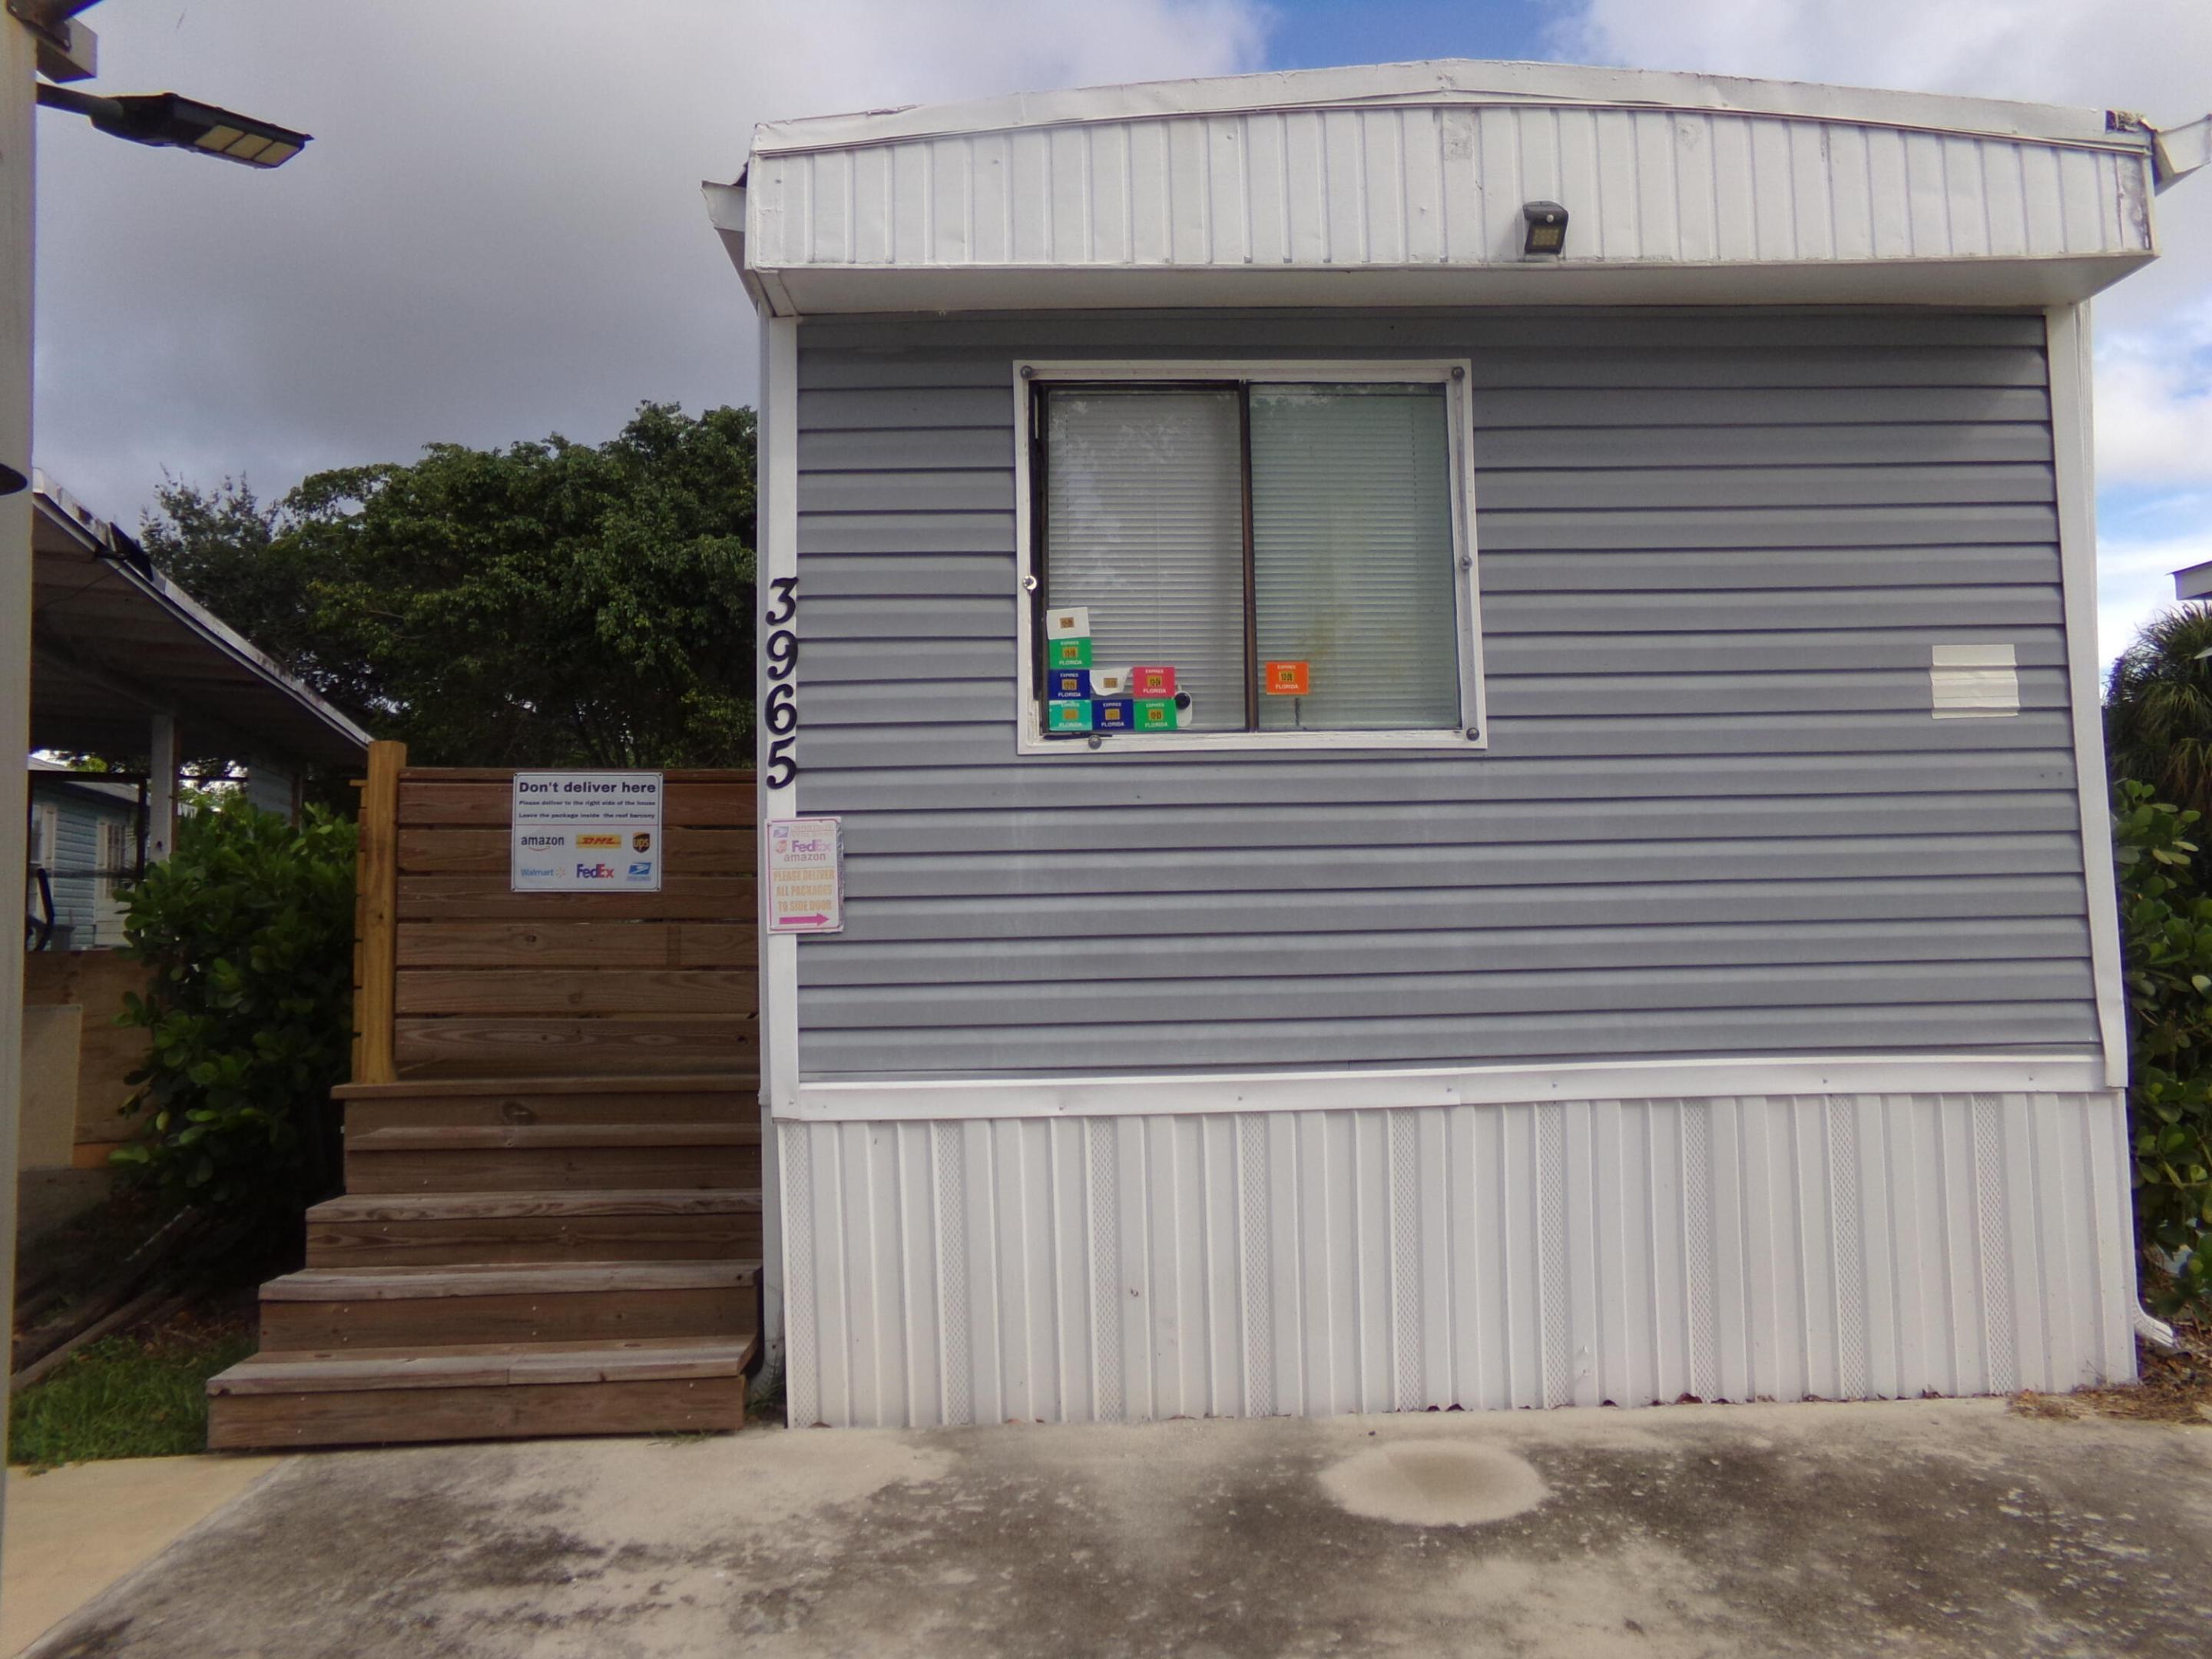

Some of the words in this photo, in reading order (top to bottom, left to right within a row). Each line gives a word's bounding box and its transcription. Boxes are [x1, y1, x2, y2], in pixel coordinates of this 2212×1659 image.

[765, 577, 799, 790] 3965
[518, 781, 559, 793] Don't
[564, 781, 617, 793] deliver
[621, 782, 656, 793] here
[521, 836, 565, 846] amazon
[634, 838, 649, 850] ups
[791, 839, 832, 853] FedEx
[783, 853, 826, 863] amazon
[521, 869, 554, 877] Walmart
[576, 863, 614, 879] FedEx
[773, 870, 802, 882] PLEASE
[803, 869, 835, 881] DELIVER
[777, 886, 789, 897] ALL
[777, 901, 788, 912] TO
[790, 900, 809, 912] SIDE
[810, 899, 832, 912] DOOR
